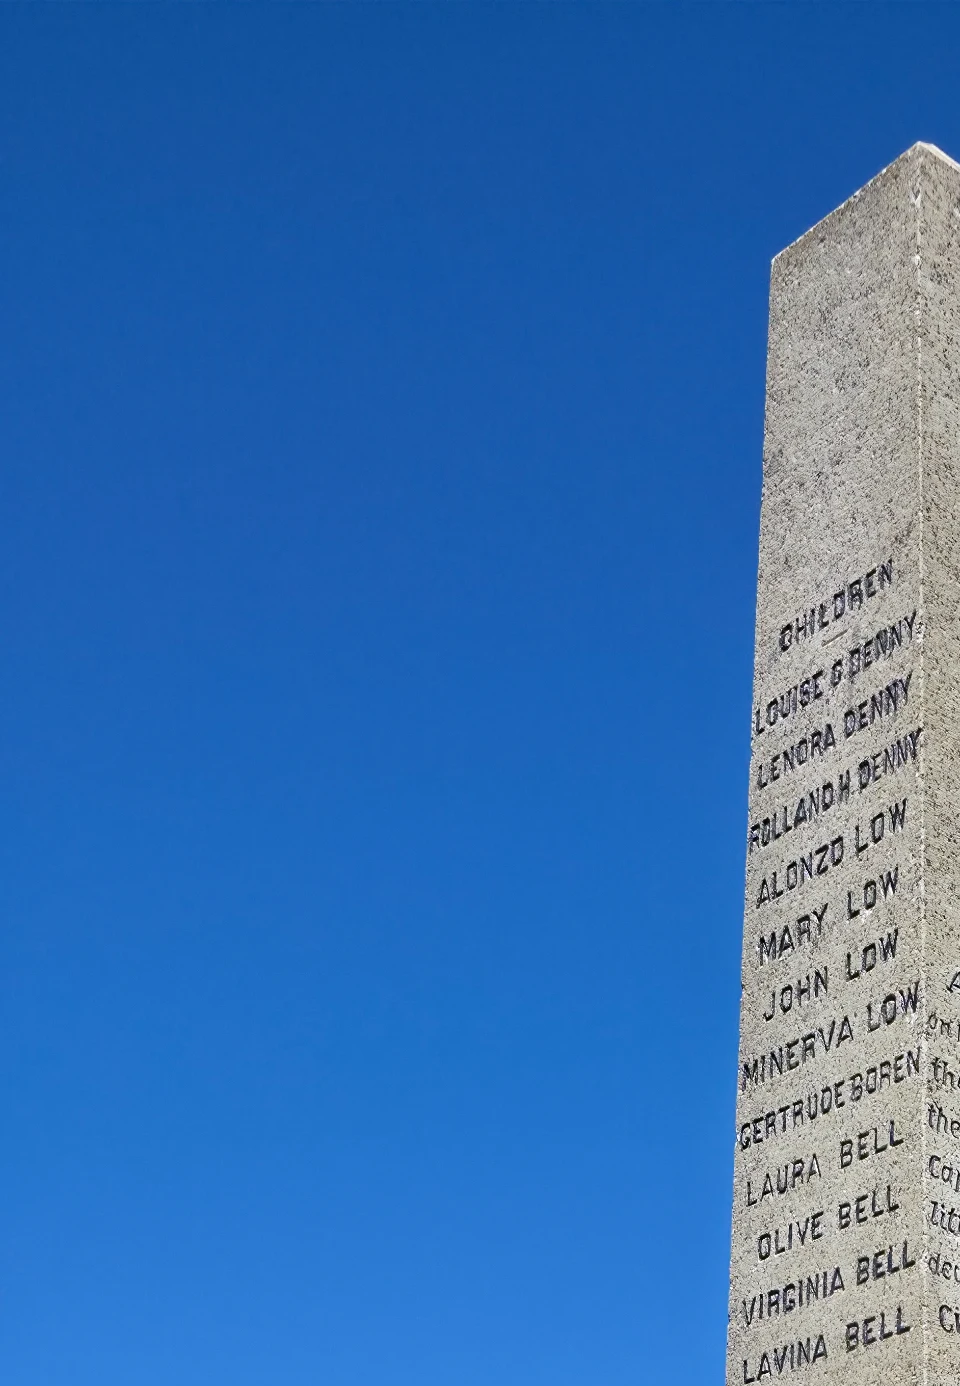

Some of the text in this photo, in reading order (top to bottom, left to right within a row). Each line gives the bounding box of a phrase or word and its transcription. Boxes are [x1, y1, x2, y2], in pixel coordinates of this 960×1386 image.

[779, 558, 893, 653] CHILDREN
[755, 672, 823, 736] LOUISE
[848, 611, 917, 679] DENNY
[757, 674, 912, 789] LENORA DENNY
[749, 784, 835, 852] ROLLAND
[858, 728, 923, 793] DENNY
[757, 798, 907, 909] ALONZO LOW
[759, 868, 899, 965] MARY LOW
[763, 928, 898, 1022] JOHN LOW
[741, 982, 919, 1090] MINERVA LOW
[929, 1013, 954, 1036] on
[739, 1047, 922, 1151] GERTRUDE BOREN
[927, 1104, 960, 1138] the
[746, 1120, 904, 1208] LAURA BELL
[758, 1185, 899, 1261] OLIVE BELL
[742, 1240, 916, 1327] VIRGINIA BELL
[743, 1306, 911, 1385] LAVINA BELL
